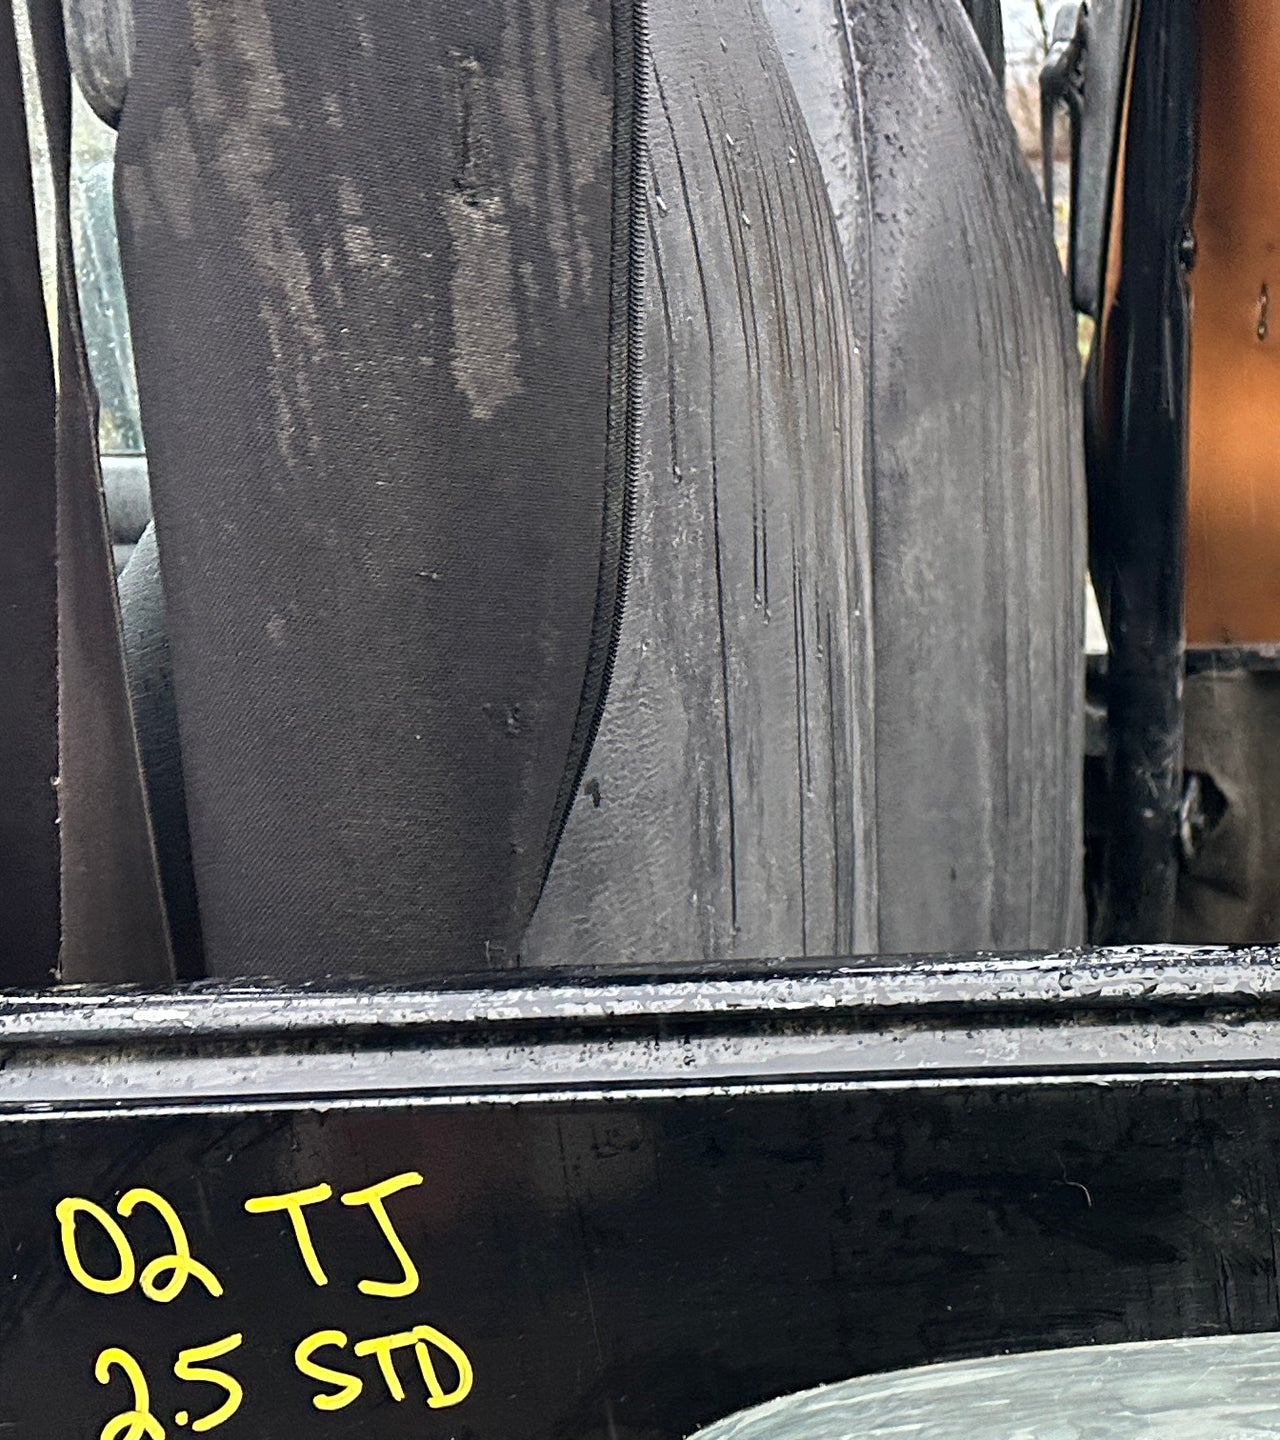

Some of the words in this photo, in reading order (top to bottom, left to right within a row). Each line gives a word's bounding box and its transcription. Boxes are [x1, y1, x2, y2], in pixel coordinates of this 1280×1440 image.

[56, 1188, 223, 1302] 02
[245, 1172, 423, 1297] TJ
[295, 1325, 474, 1410] STD
